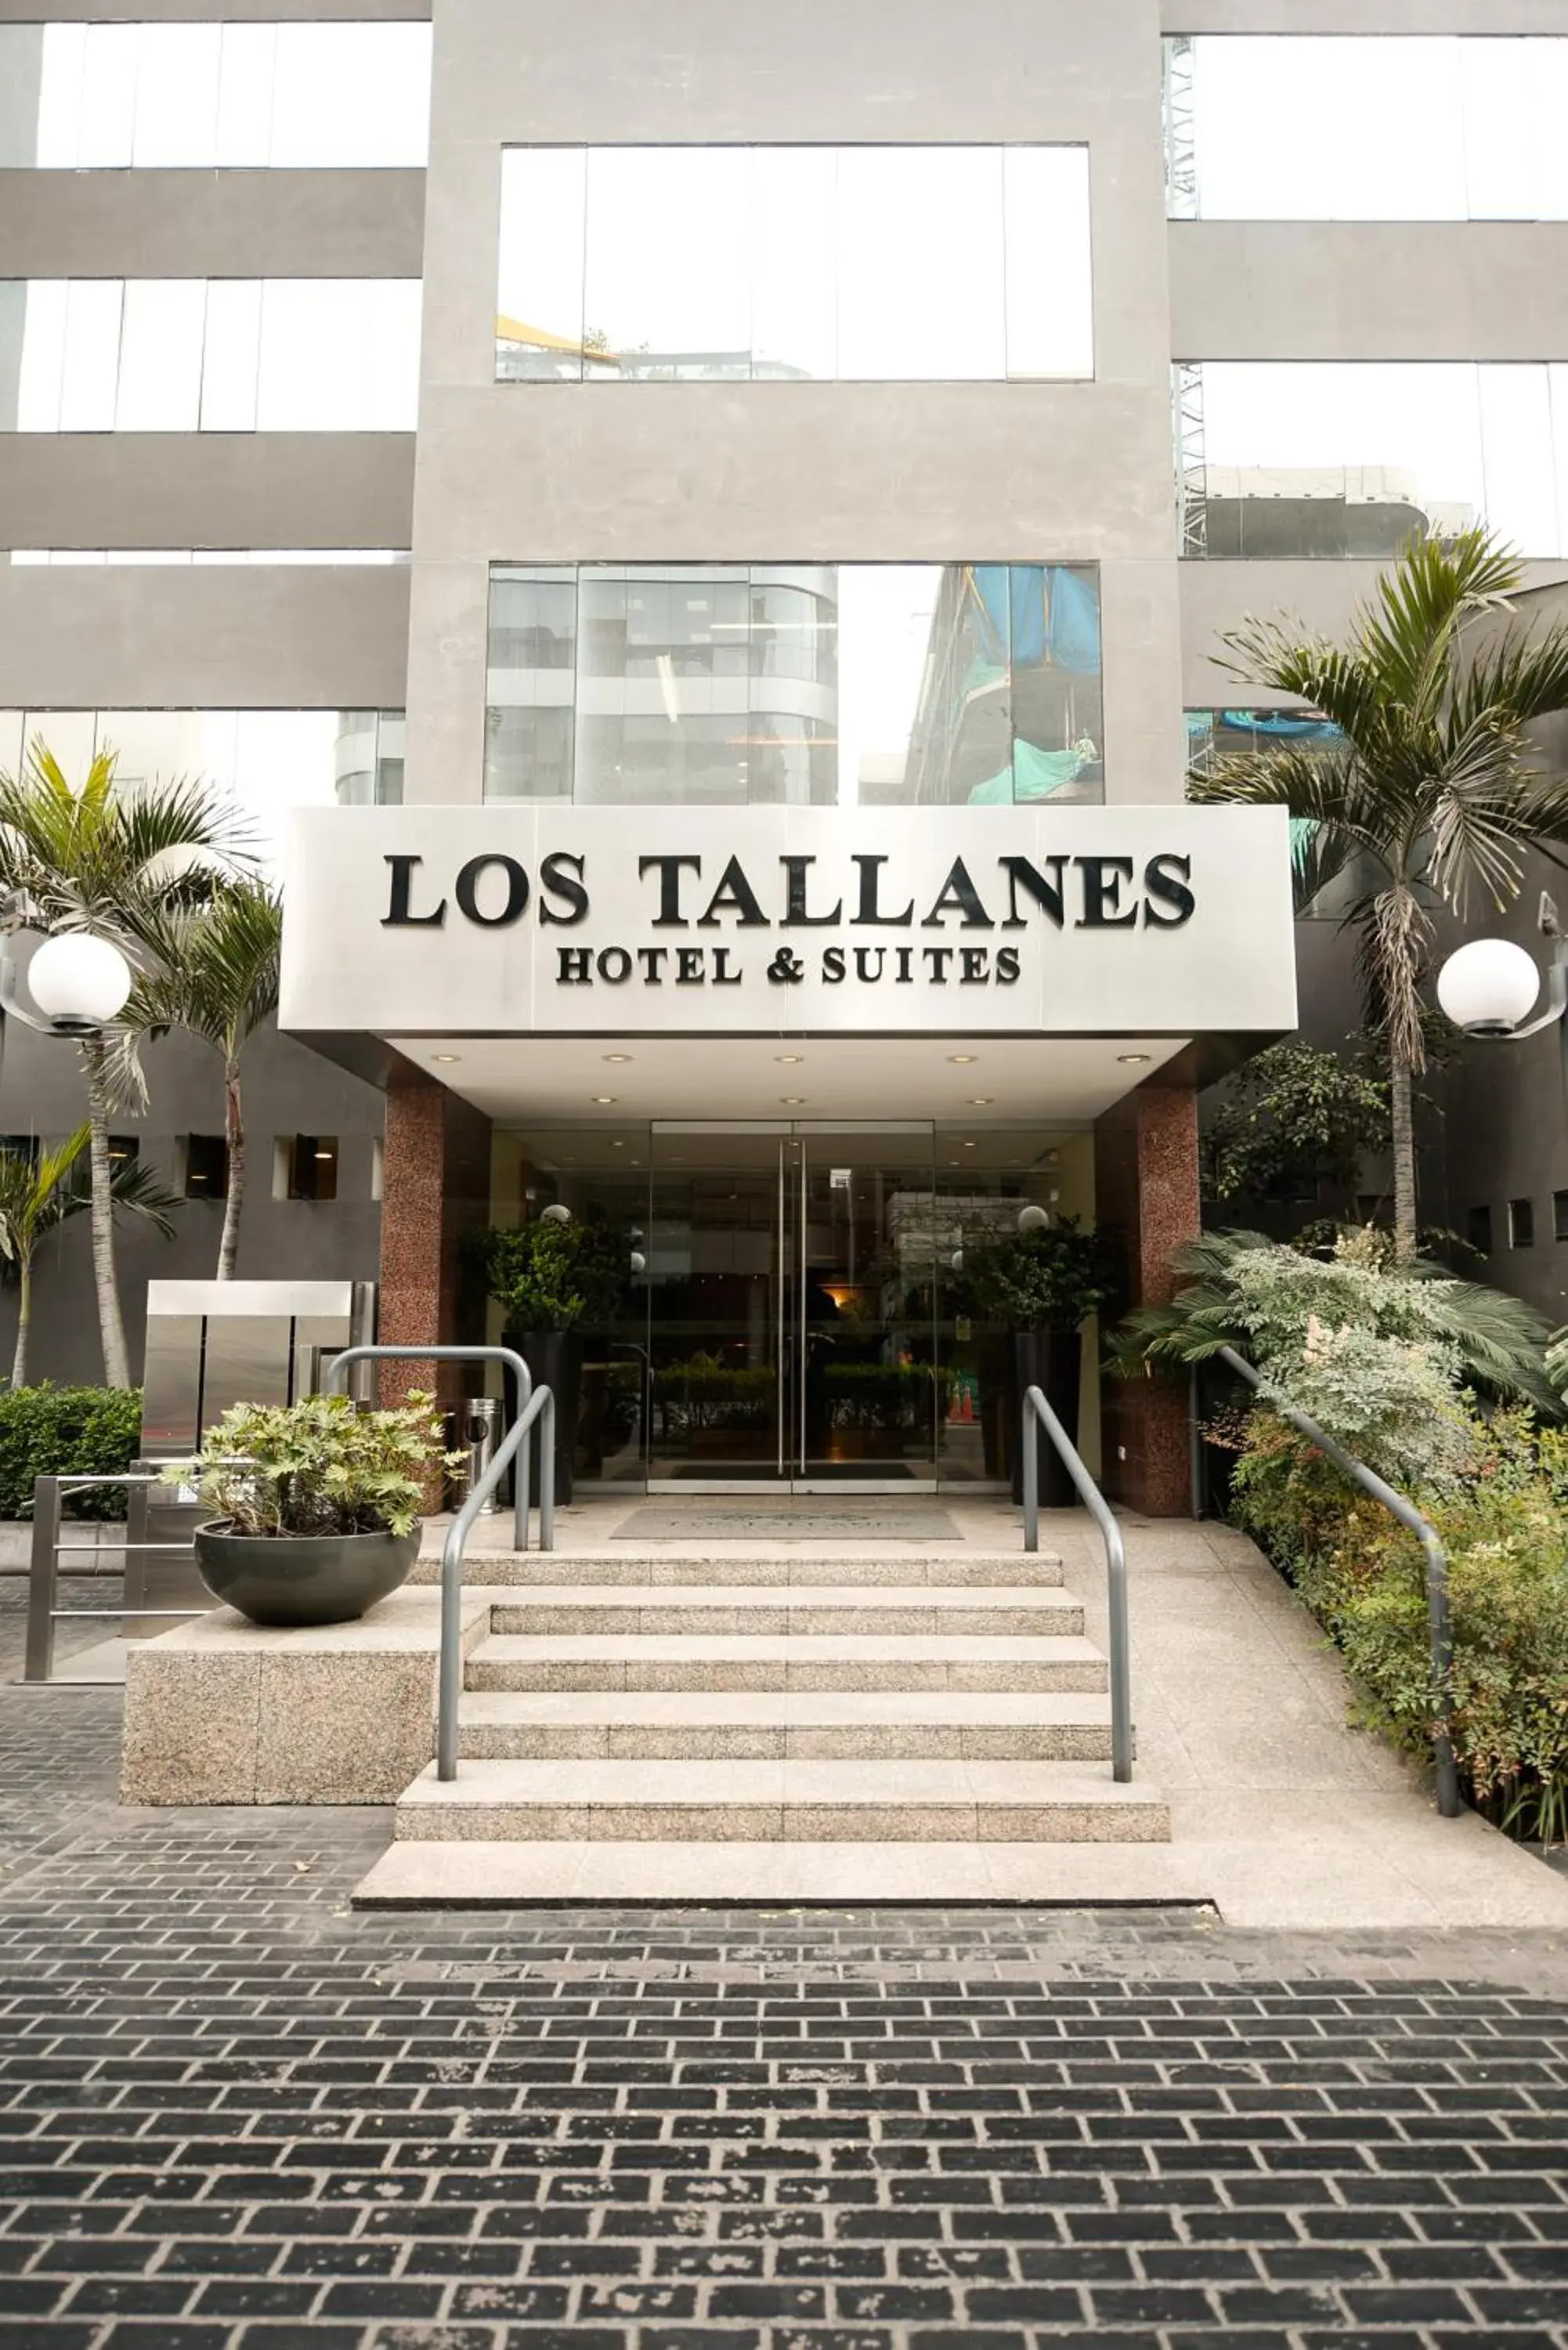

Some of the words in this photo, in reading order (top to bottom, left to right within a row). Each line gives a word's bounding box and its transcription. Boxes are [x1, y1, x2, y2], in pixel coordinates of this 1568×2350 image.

[380, 851, 590, 929] LOS
[638, 853, 1196, 929] TALLANES
[555, 946, 742, 985] HOTEL
[767, 946, 805, 985] &
[822, 946, 1021, 985] SUITES
